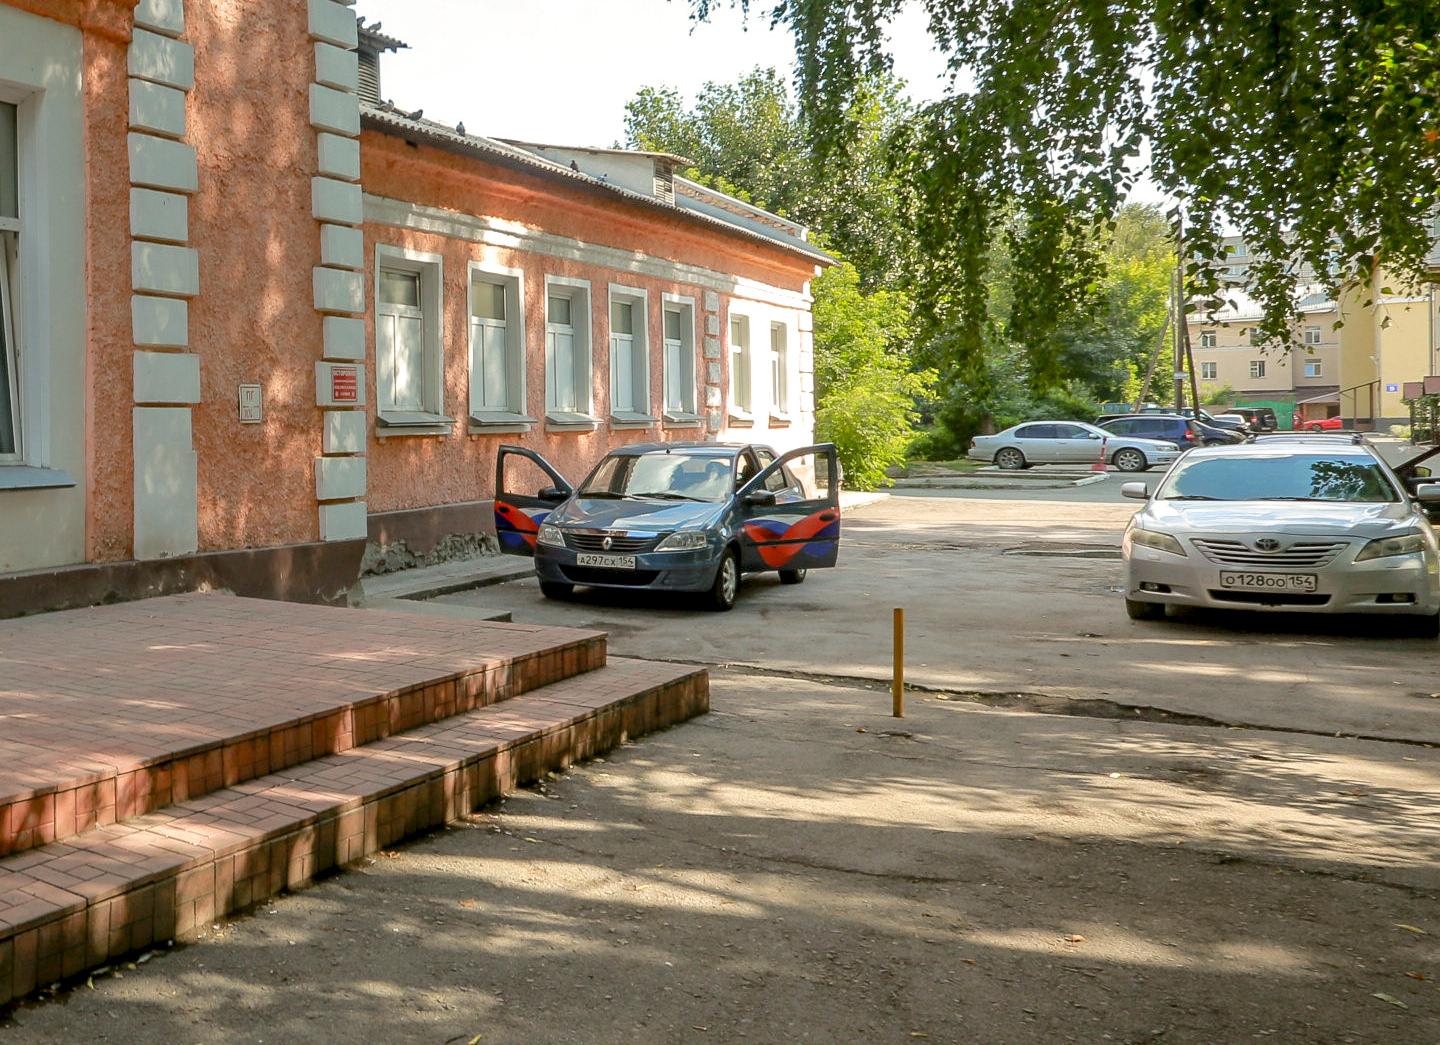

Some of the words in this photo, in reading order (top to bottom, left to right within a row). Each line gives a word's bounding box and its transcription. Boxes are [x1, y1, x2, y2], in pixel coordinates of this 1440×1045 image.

[580, 555, 616, 566] А297СХ
[620, 556, 634, 565] 154
[1225, 574, 1286, 587] О128ОО
[1288, 576, 1313, 586] 154
